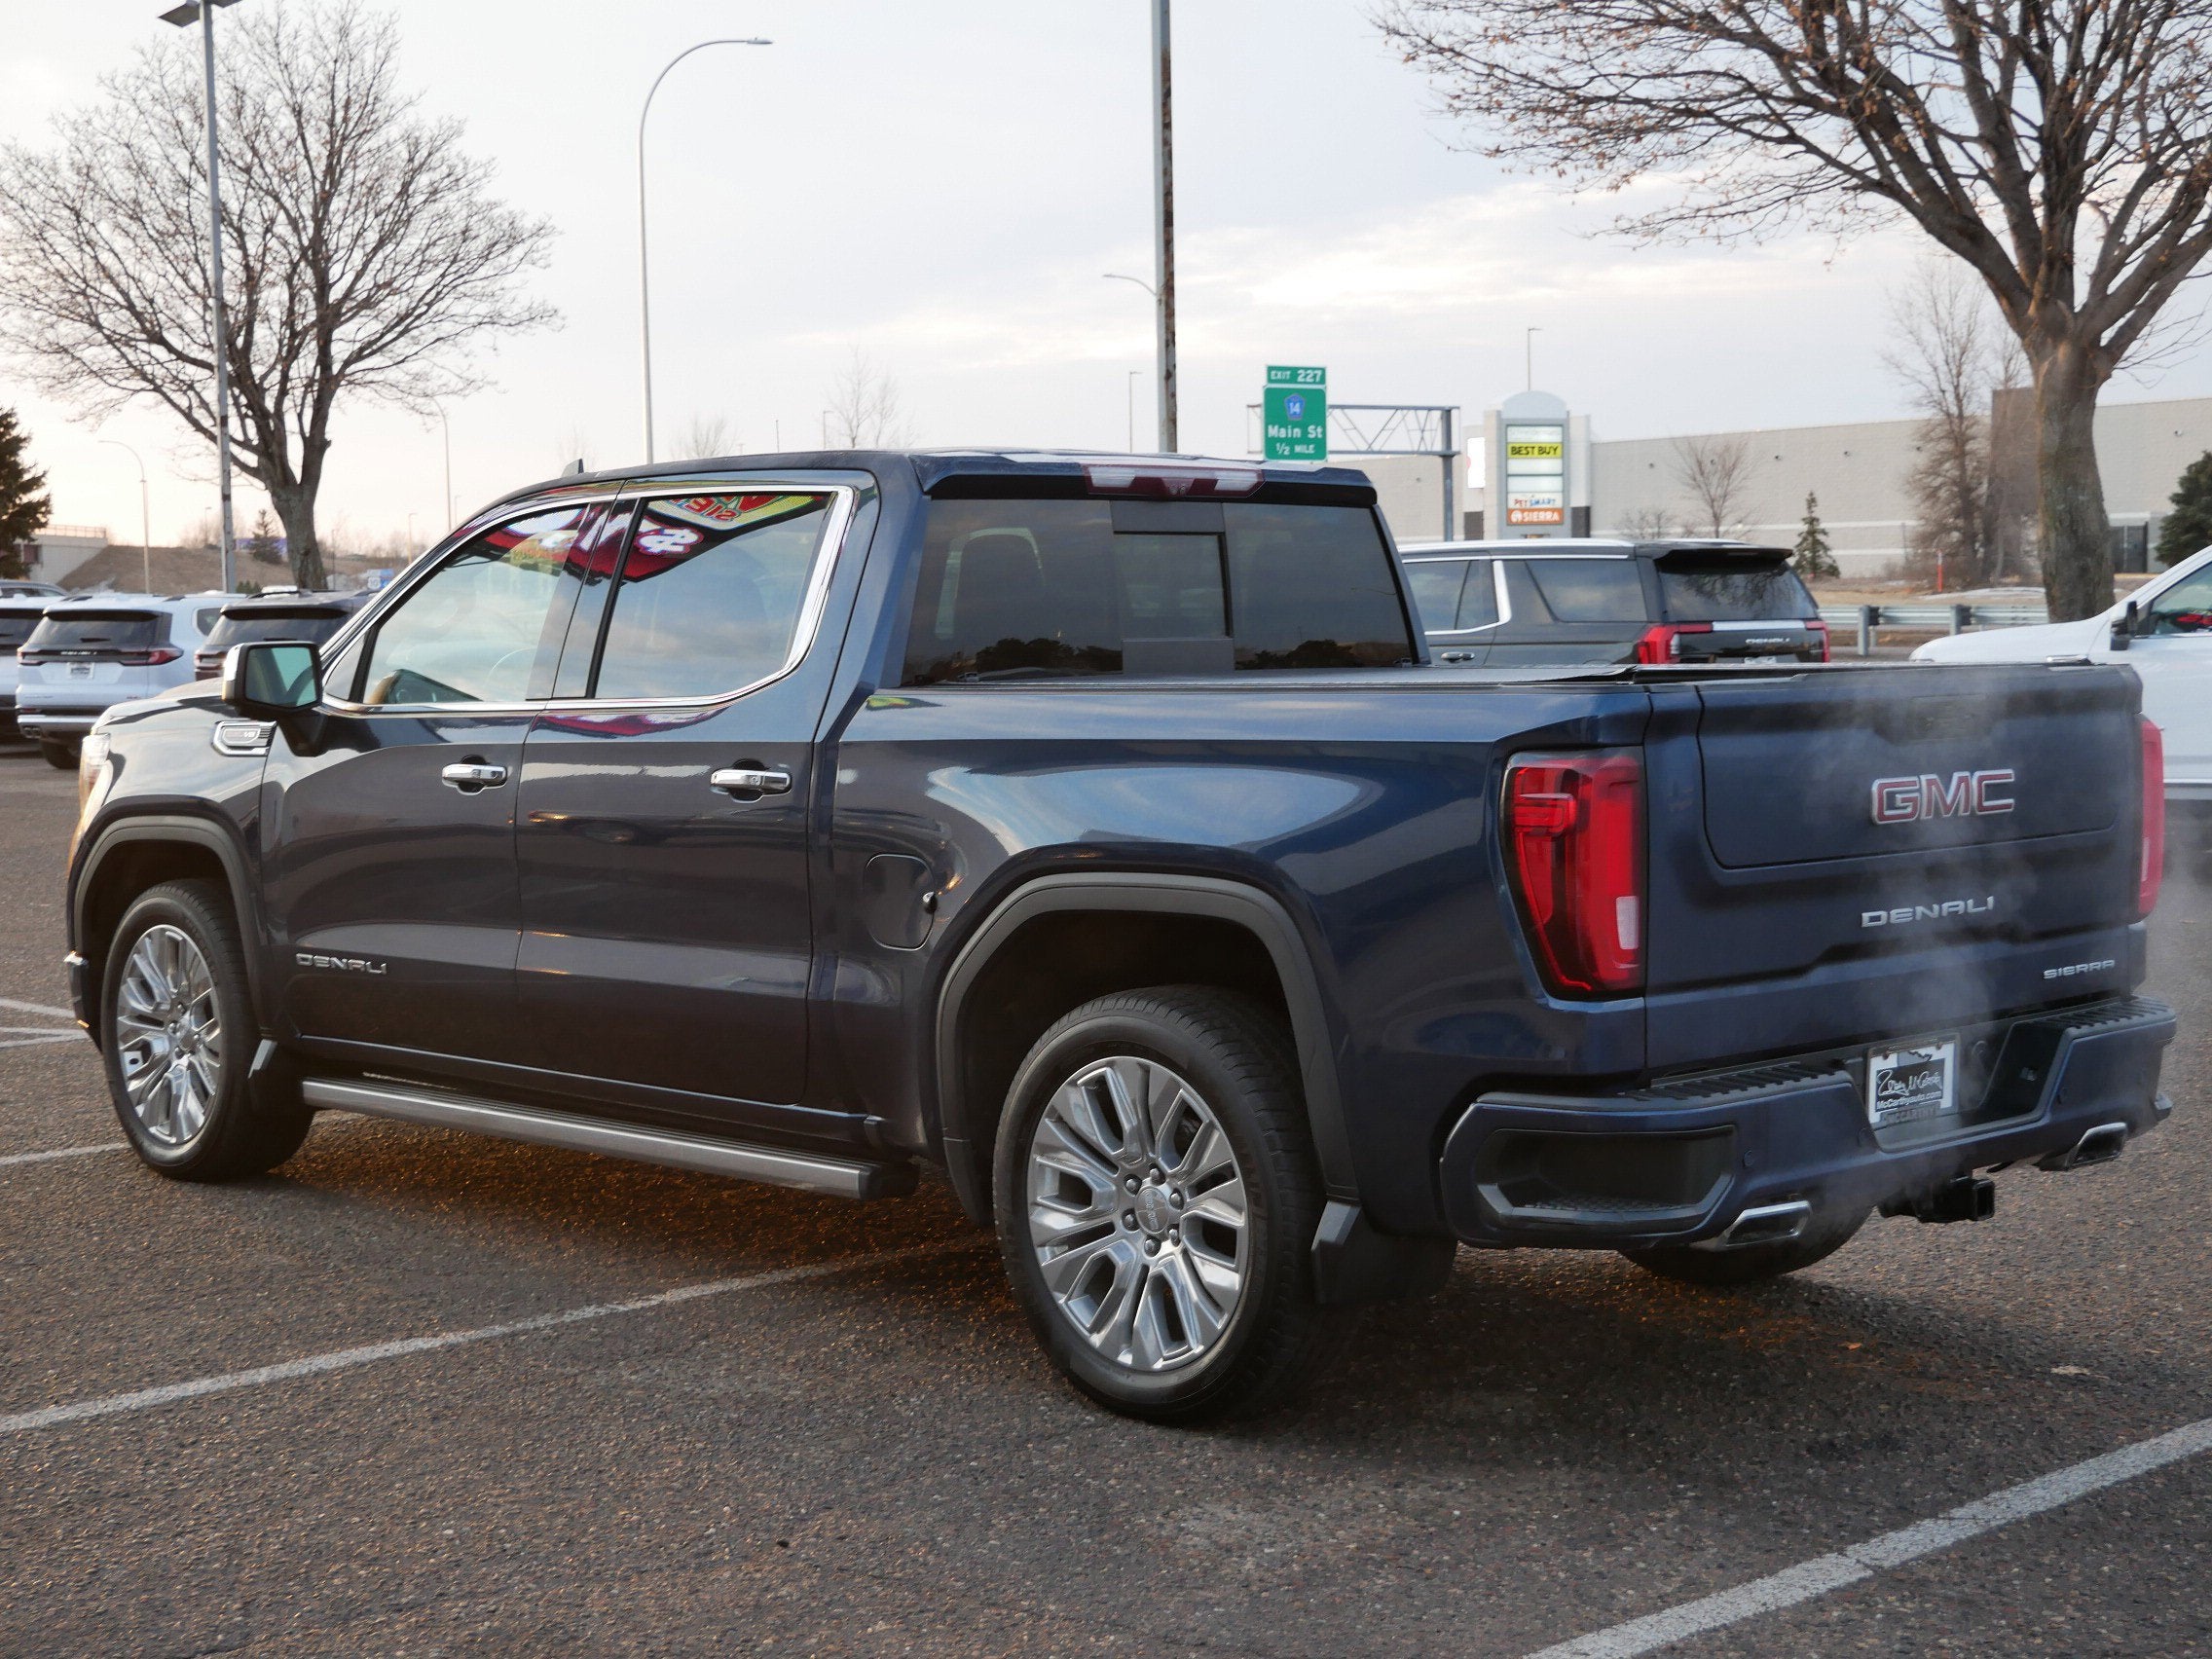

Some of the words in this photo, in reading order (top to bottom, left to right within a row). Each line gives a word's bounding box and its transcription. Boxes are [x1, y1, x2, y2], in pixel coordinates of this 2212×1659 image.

[1270, 370, 1291, 381] EXIT
[1296, 369, 1322, 383] 227
[1289, 401, 1300, 415] 14
[1268, 424, 1302, 438] Main
[1307, 424, 1324, 439] St
[1294, 444, 1316, 454] MILE
[1510, 446, 1536, 456] BEST
[1537, 445, 1559, 456] BUY
[1522, 510, 1561, 522] SIERRA
[1872, 768, 2014, 825] GMC
[1861, 896, 1995, 928] DENALI
[295, 953, 387, 975] DENALI
[2044, 959, 2116, 979] SIERRA
